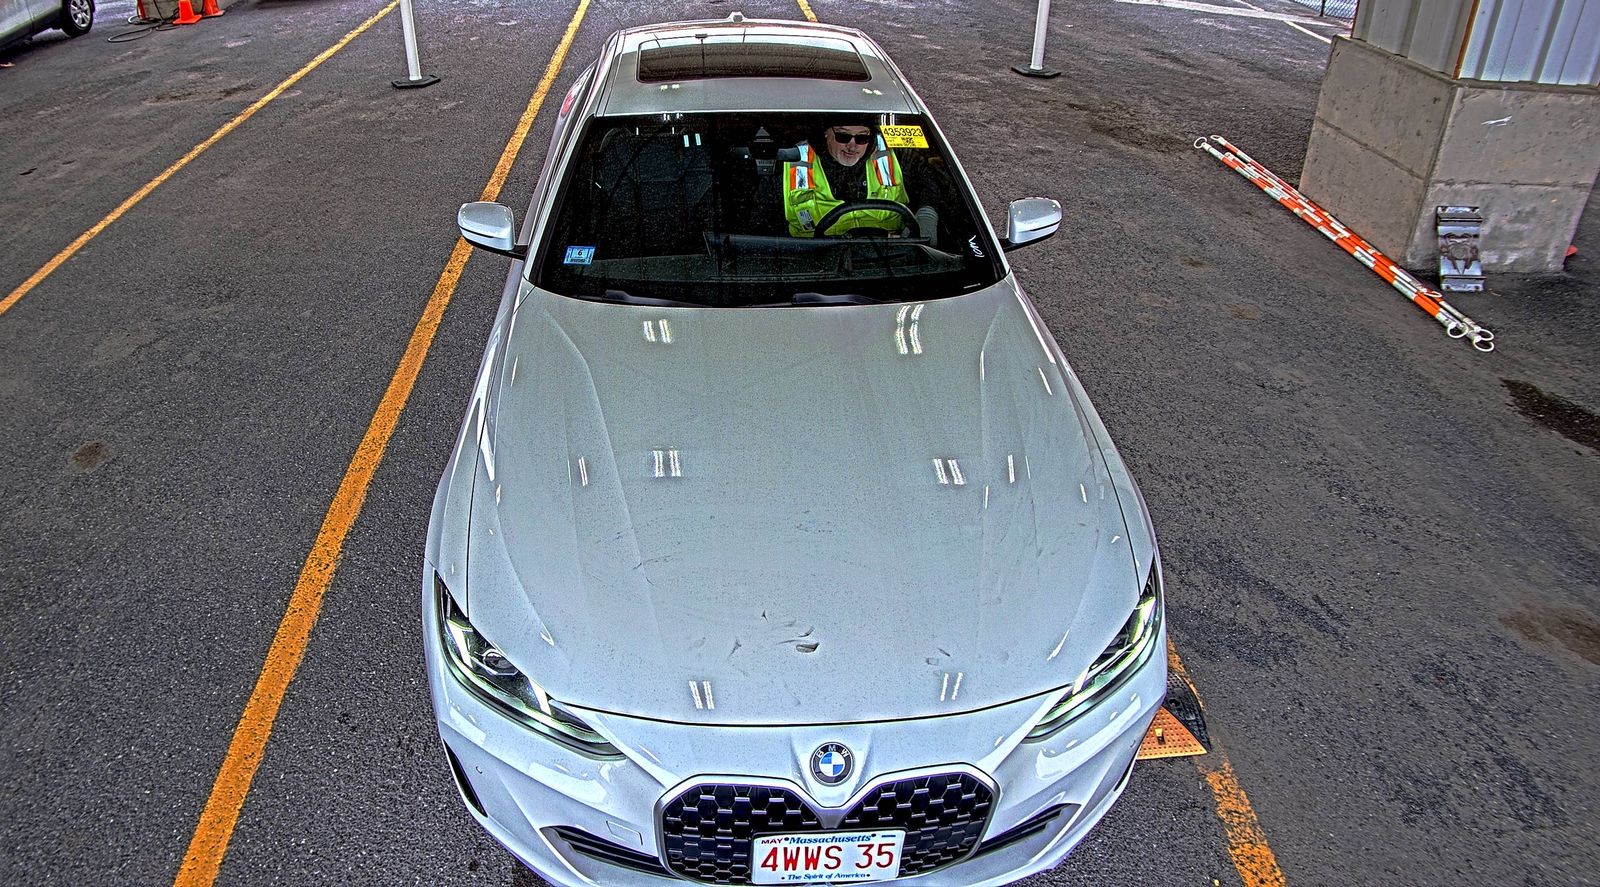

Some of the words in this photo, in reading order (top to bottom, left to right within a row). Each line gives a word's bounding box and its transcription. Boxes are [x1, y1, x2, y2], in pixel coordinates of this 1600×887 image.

[883, 127, 923, 137] 4353923
[815, 744, 850, 759] BMW
[789, 834, 872, 845] Massachusetts
[760, 845, 843, 872] 4WWS
[855, 842, 896, 869] 35
[803, 873, 824, 881] Spirit
[825, 872, 834, 880] of
